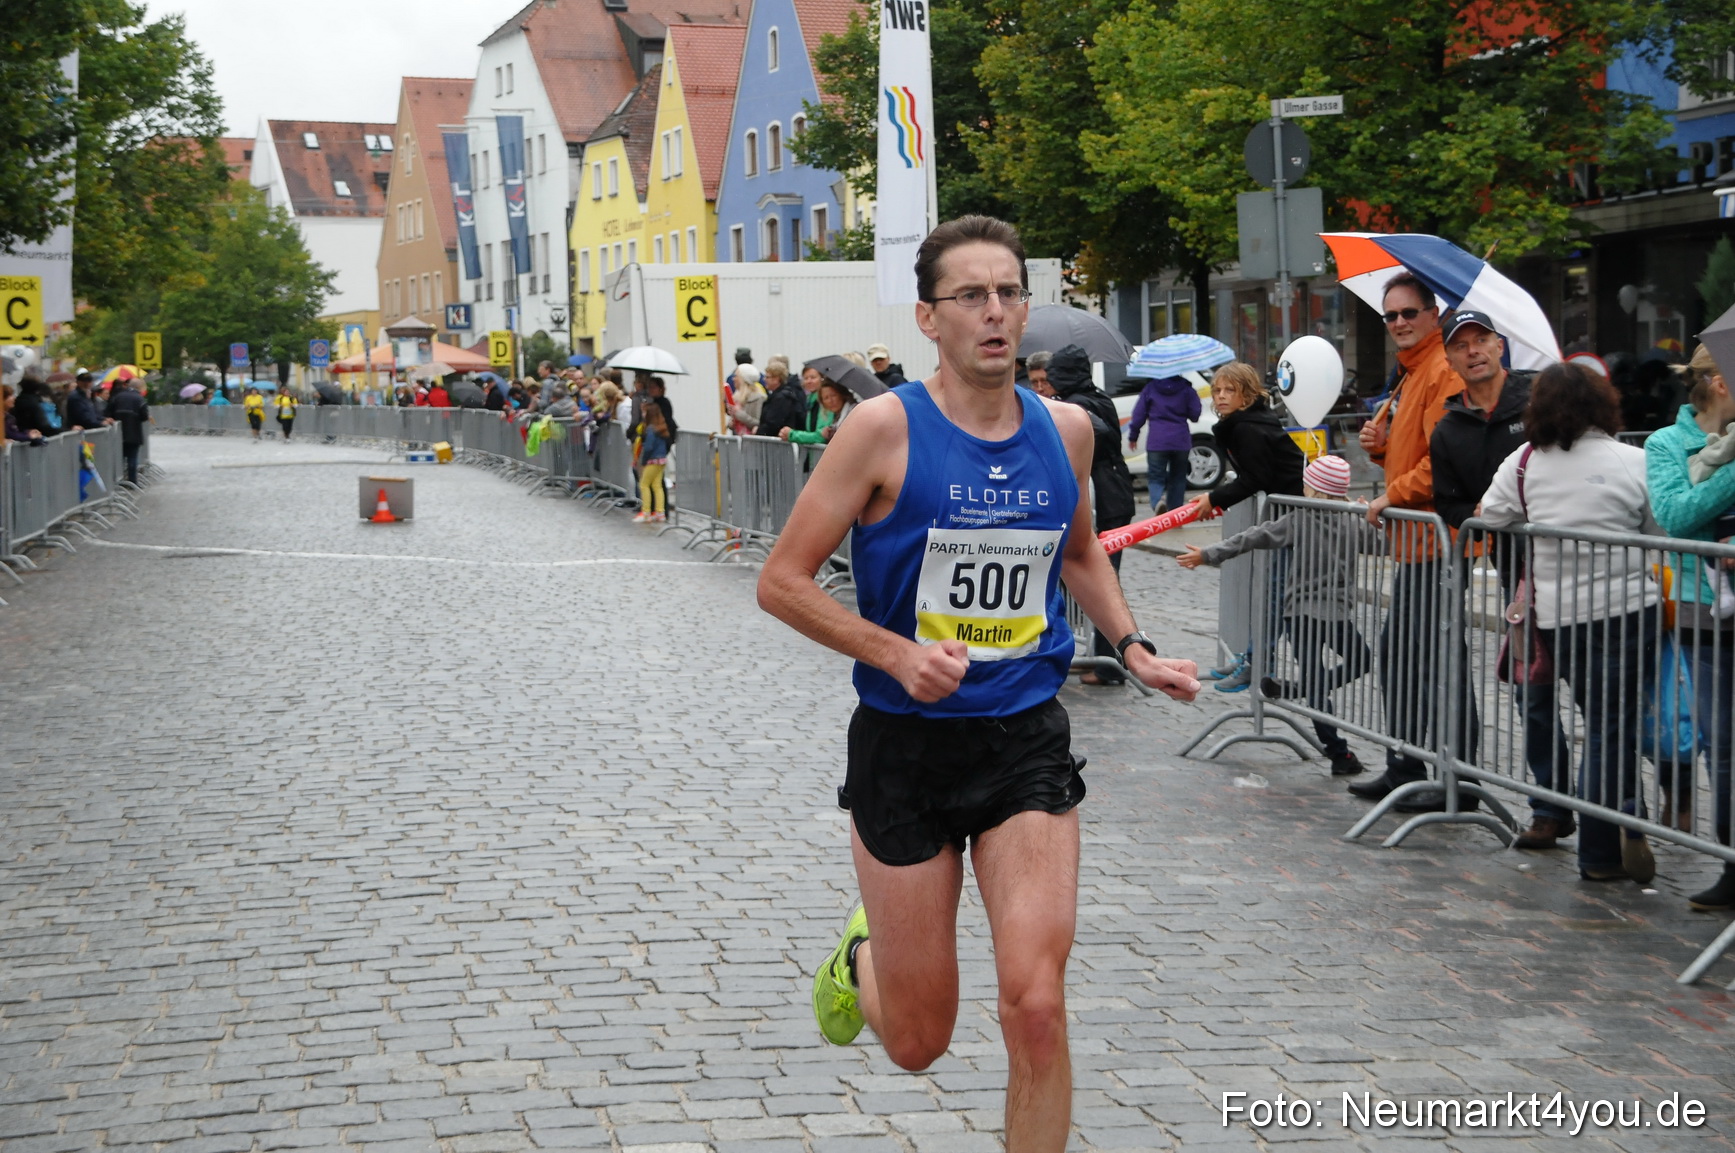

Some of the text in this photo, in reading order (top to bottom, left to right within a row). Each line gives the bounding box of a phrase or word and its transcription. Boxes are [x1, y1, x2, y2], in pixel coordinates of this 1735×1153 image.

[1284, 100, 1338, 113] Ulmer Gasse
[0, 278, 37, 291] Block
[679, 278, 714, 291] Block
[7, 297, 31, 330] C
[687, 295, 709, 328] C
[143, 343, 155, 361] D
[496, 341, 507, 358] D
[949, 484, 1049, 506] ELOTEC
[1143, 517, 1171, 536] BKK
[929, 542, 1038, 556] PARTL Neumarkt
[949, 562, 1030, 610] 500
[921, 601, 927, 611] A
[956, 623, 1012, 643] Martin
